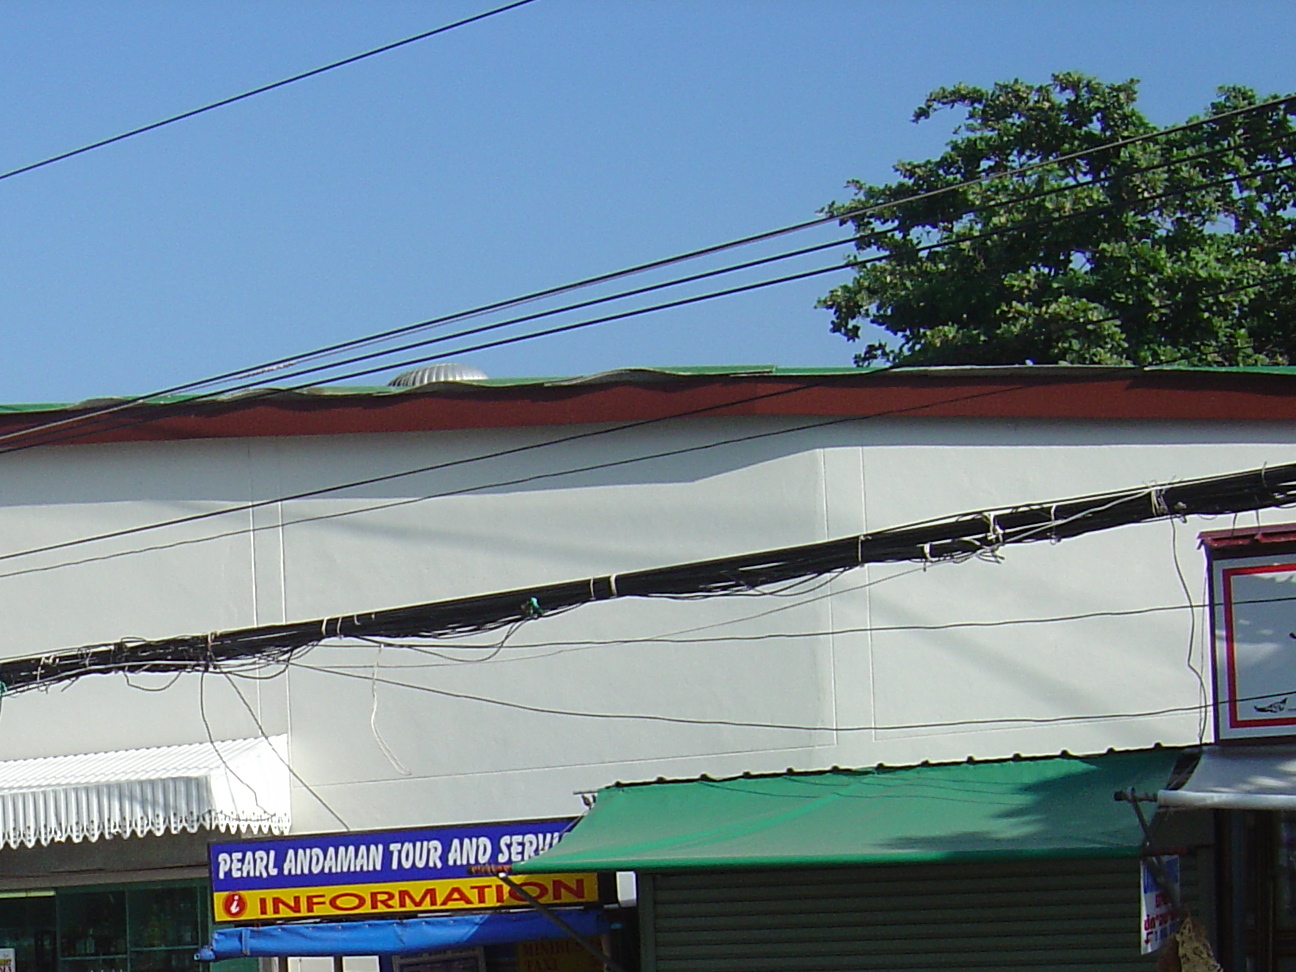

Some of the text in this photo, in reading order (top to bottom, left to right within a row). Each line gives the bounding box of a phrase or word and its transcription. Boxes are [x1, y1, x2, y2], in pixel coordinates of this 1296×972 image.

[218, 850, 278, 879] PEARL
[283, 843, 383, 876] ANDAMAN
[389, 840, 442, 870] TOUR
[448, 836, 492, 866] AND
[260, 878, 586, 916] INFORMATION
